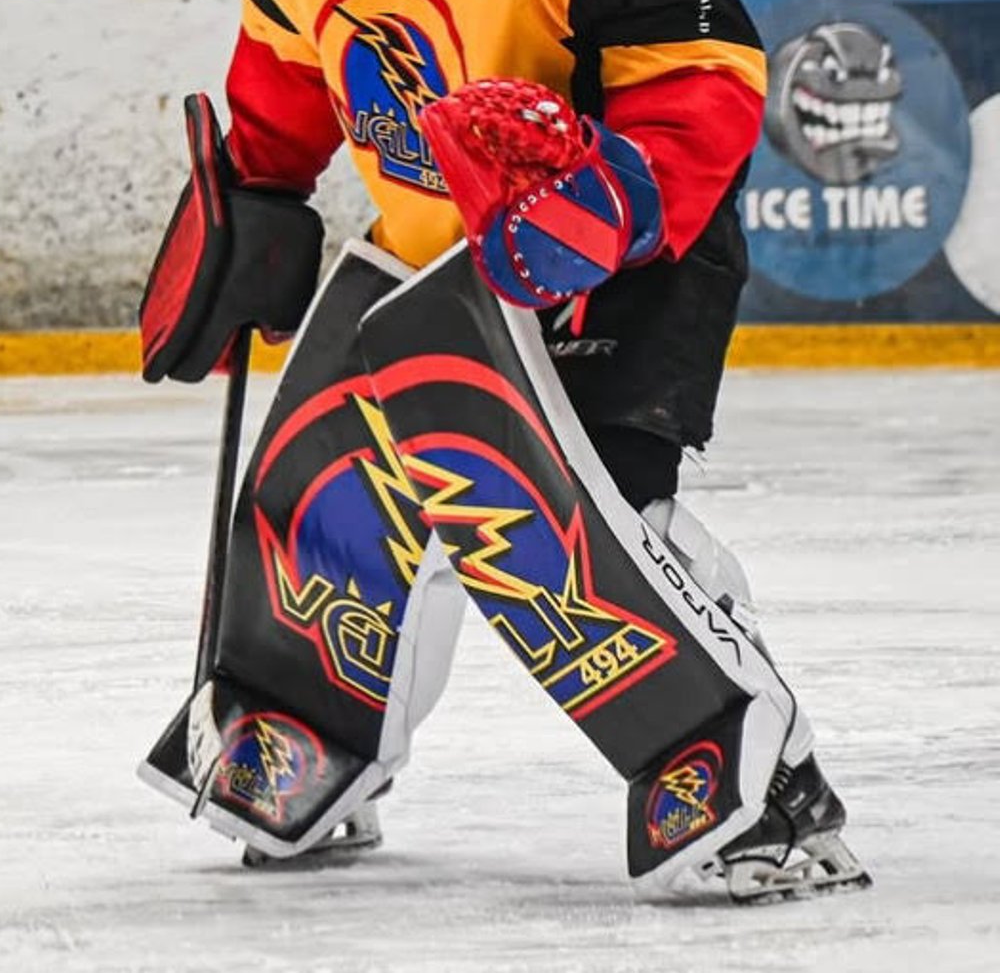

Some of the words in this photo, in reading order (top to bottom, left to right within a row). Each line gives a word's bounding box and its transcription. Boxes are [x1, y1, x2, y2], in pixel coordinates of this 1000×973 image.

[745, 187, 813, 230] ICE
[822, 185, 928, 230] TIME
[640, 523, 743, 667] VAPOR
[578, 632, 640, 688] 494
